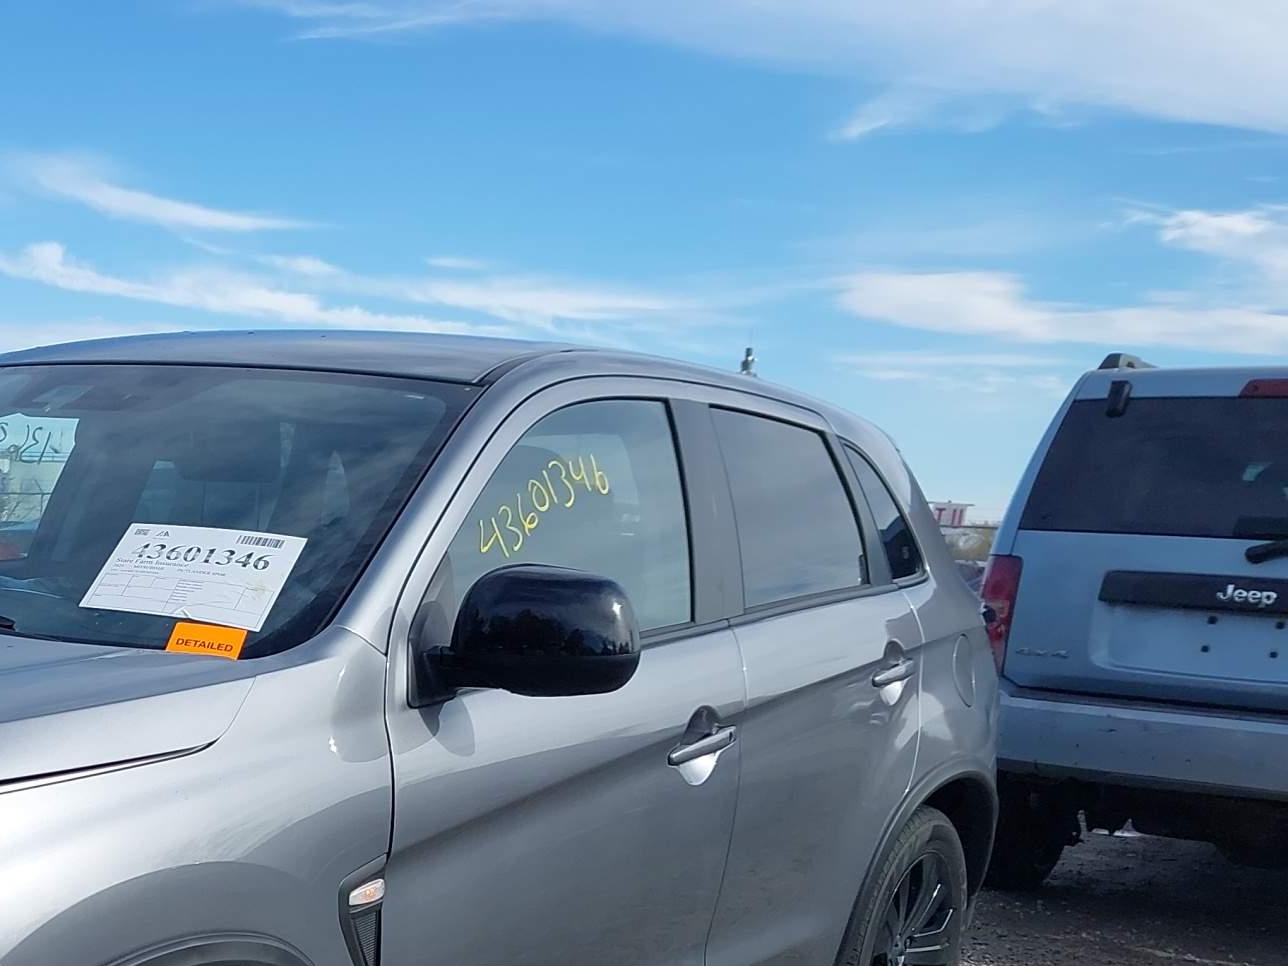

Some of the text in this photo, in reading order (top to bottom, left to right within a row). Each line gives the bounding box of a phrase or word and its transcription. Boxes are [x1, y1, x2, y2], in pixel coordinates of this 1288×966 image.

[479, 453, 610, 558] 43601346
[131, 543, 276, 571] 43601346
[1216, 584, 1277, 608] Jeep
[175, 637, 234, 652] DETAILED
